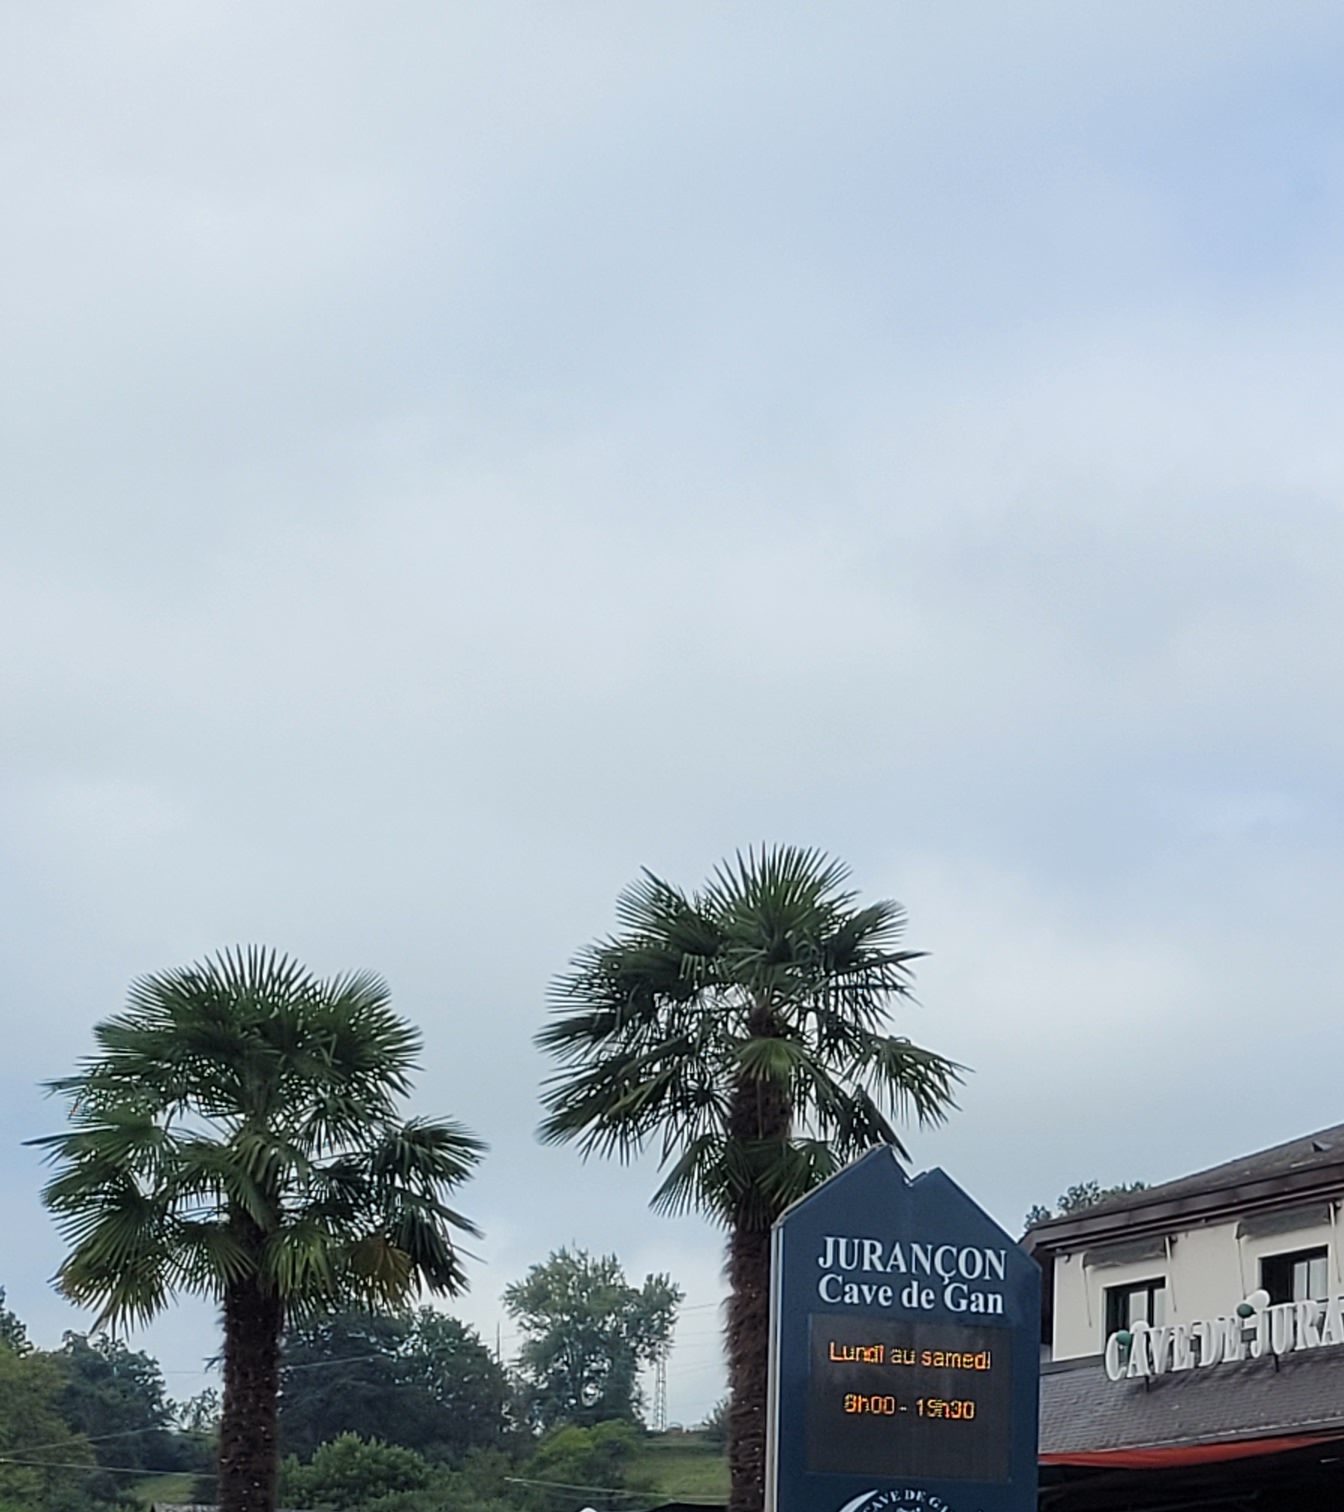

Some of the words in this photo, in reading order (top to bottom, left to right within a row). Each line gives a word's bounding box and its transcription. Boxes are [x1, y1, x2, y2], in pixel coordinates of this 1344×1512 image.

[818, 1236, 1006, 1285] JURANÇON
[818, 1273, 892, 1307] Cave
[901, 1280, 935, 1309] de
[944, 1283, 1003, 1314] Gan
[829, 1341, 884, 1364] Lundi
[891, 1348, 916, 1364] au
[921, 1350, 991, 1370] samedi
[1105, 1319, 1195, 1381] CAVE
[1198, 1316, 1246, 1367] DE
[904, 1489, 926, 1502] DE
